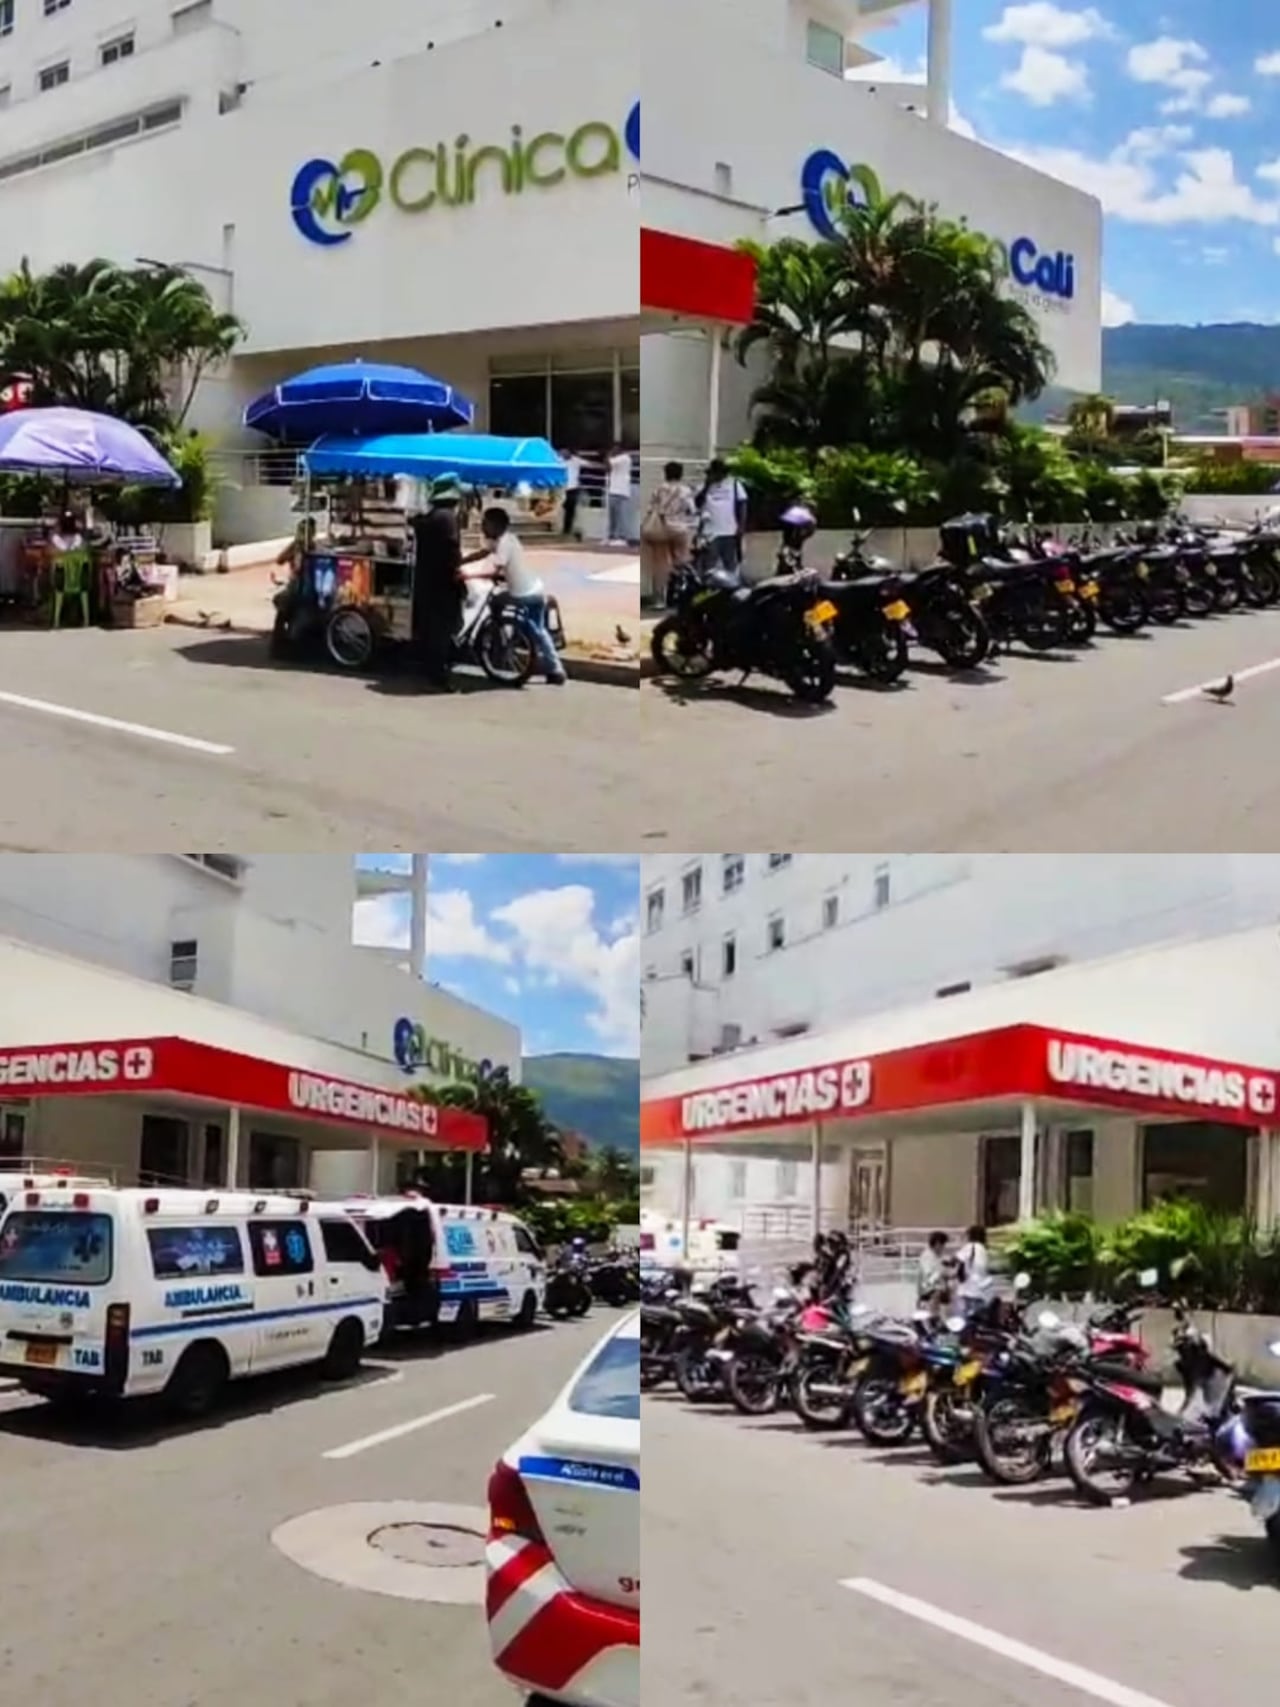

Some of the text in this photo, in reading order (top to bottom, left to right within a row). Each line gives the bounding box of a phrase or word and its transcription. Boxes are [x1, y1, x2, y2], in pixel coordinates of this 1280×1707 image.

[1009, 236, 1075, 299] Cali
[288, 1071, 420, 1131] URGENCIAS
[681, 1067, 839, 1131] URGENCIAS
[1047, 1039, 1246, 1109] URGENCIAS
